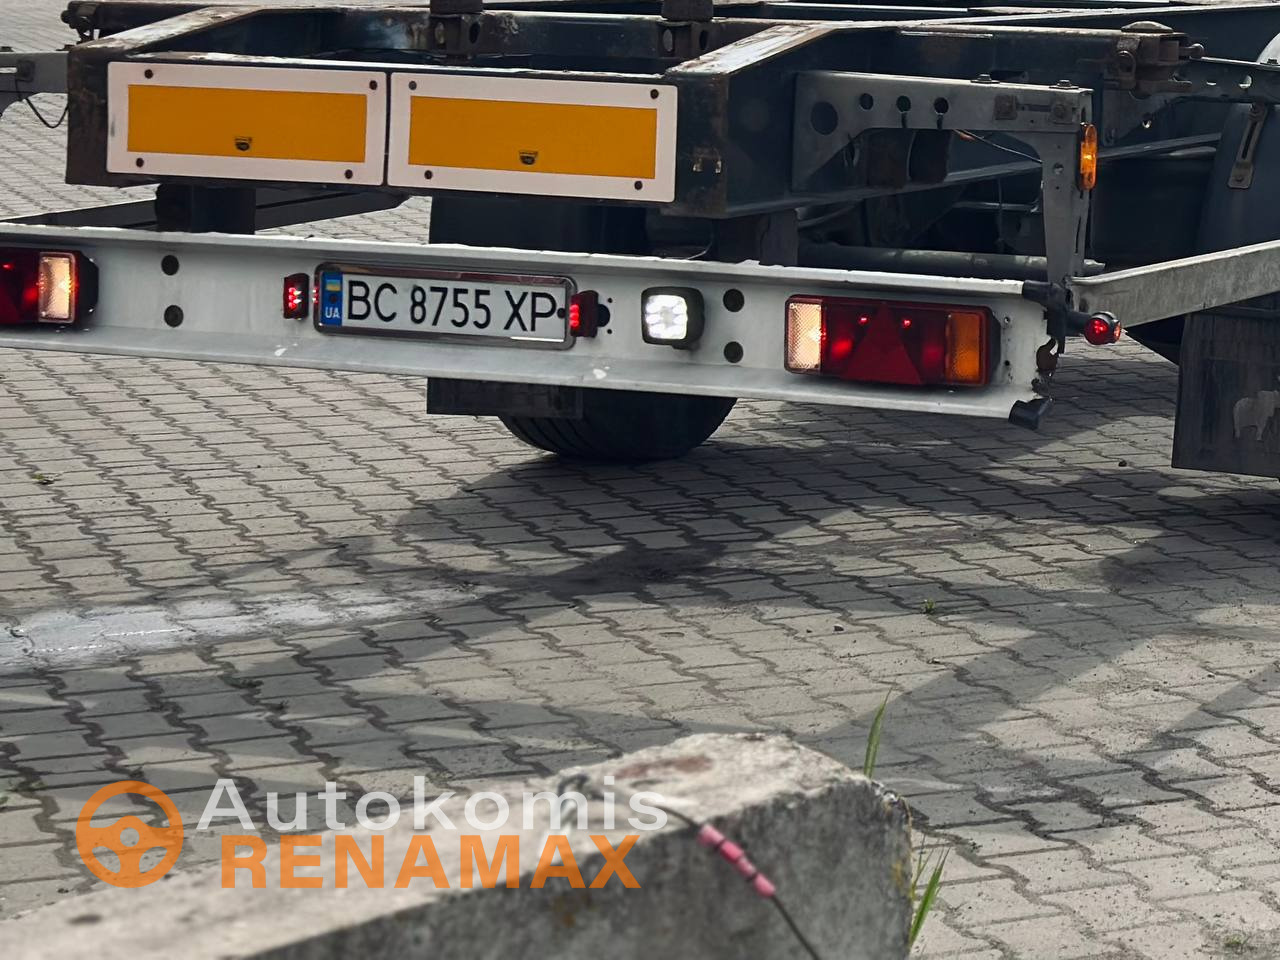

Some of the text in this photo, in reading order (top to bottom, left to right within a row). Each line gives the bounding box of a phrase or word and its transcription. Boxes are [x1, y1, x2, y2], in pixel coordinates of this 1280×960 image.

[324, 306, 340, 319] UA
[347, 280, 557, 332] BC 8755 XP
